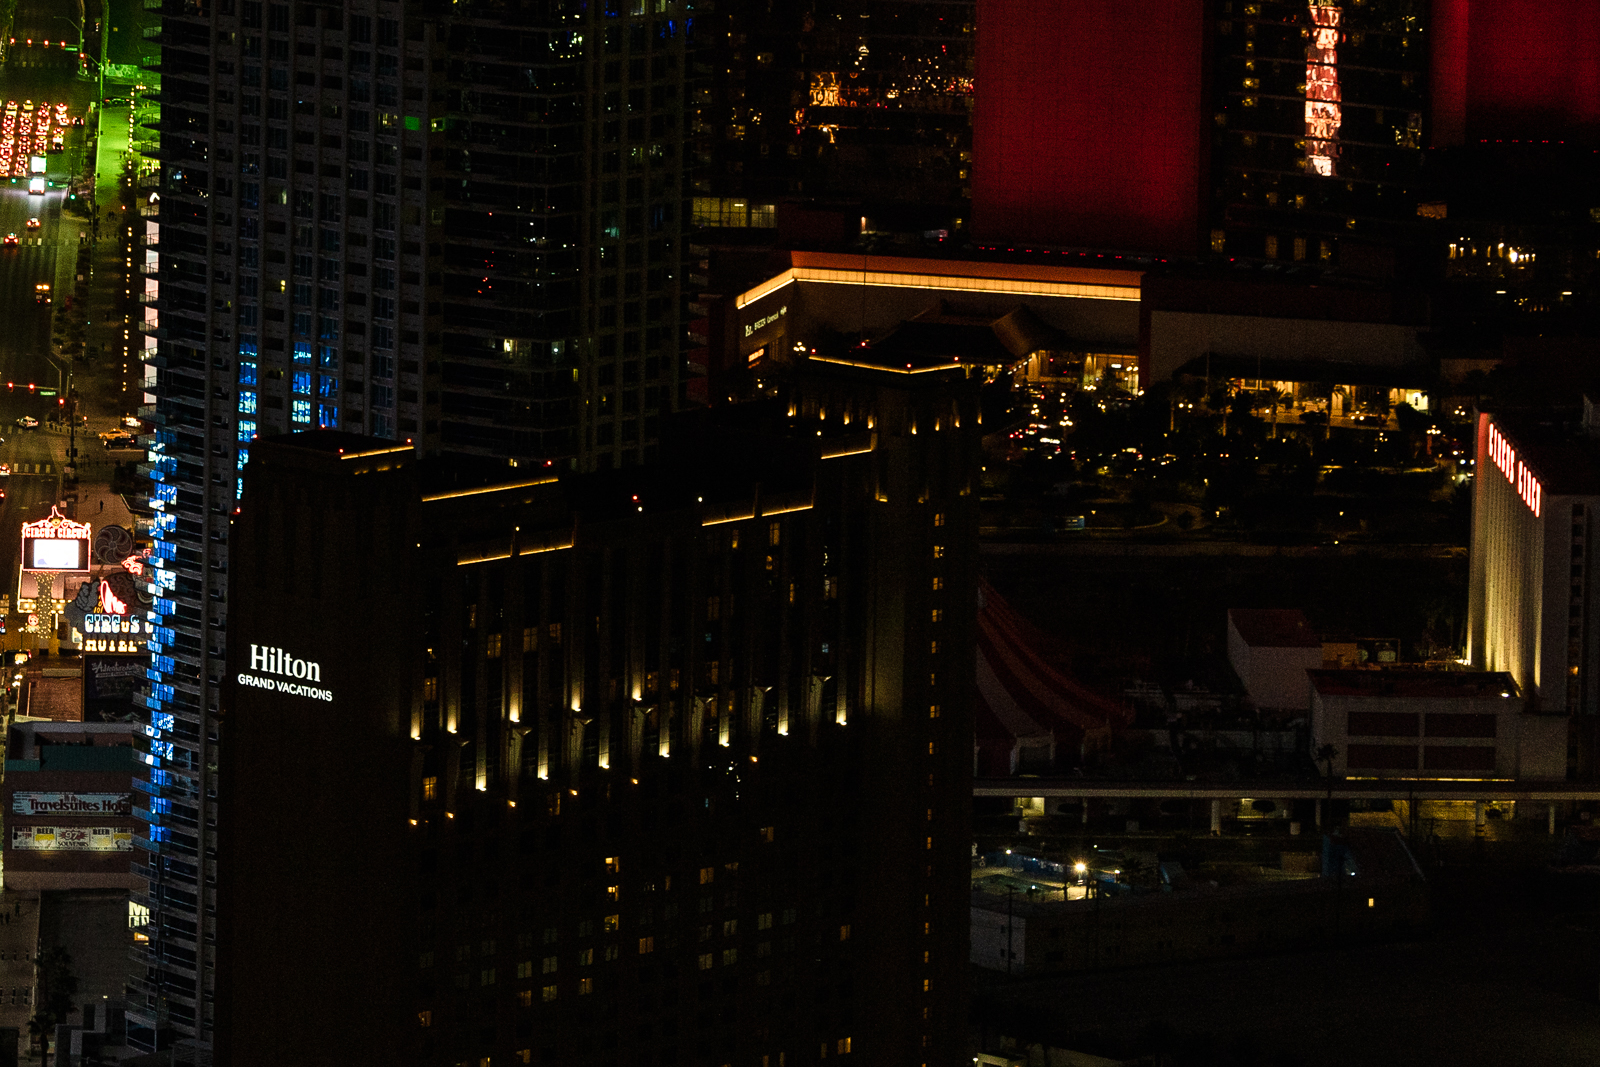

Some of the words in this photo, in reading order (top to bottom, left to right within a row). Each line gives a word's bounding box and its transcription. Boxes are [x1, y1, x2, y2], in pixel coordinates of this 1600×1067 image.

[1517, 460, 1541, 518] CIRCU
[25, 527, 55, 538] CIRCUS
[57, 527, 87, 539] CIRCUS
[250, 644, 321, 682] Hilton
[238, 673, 275, 690] GRAND
[276, 680, 333, 702] VACATIONS
[28, 798, 99, 811] Travelsuites
